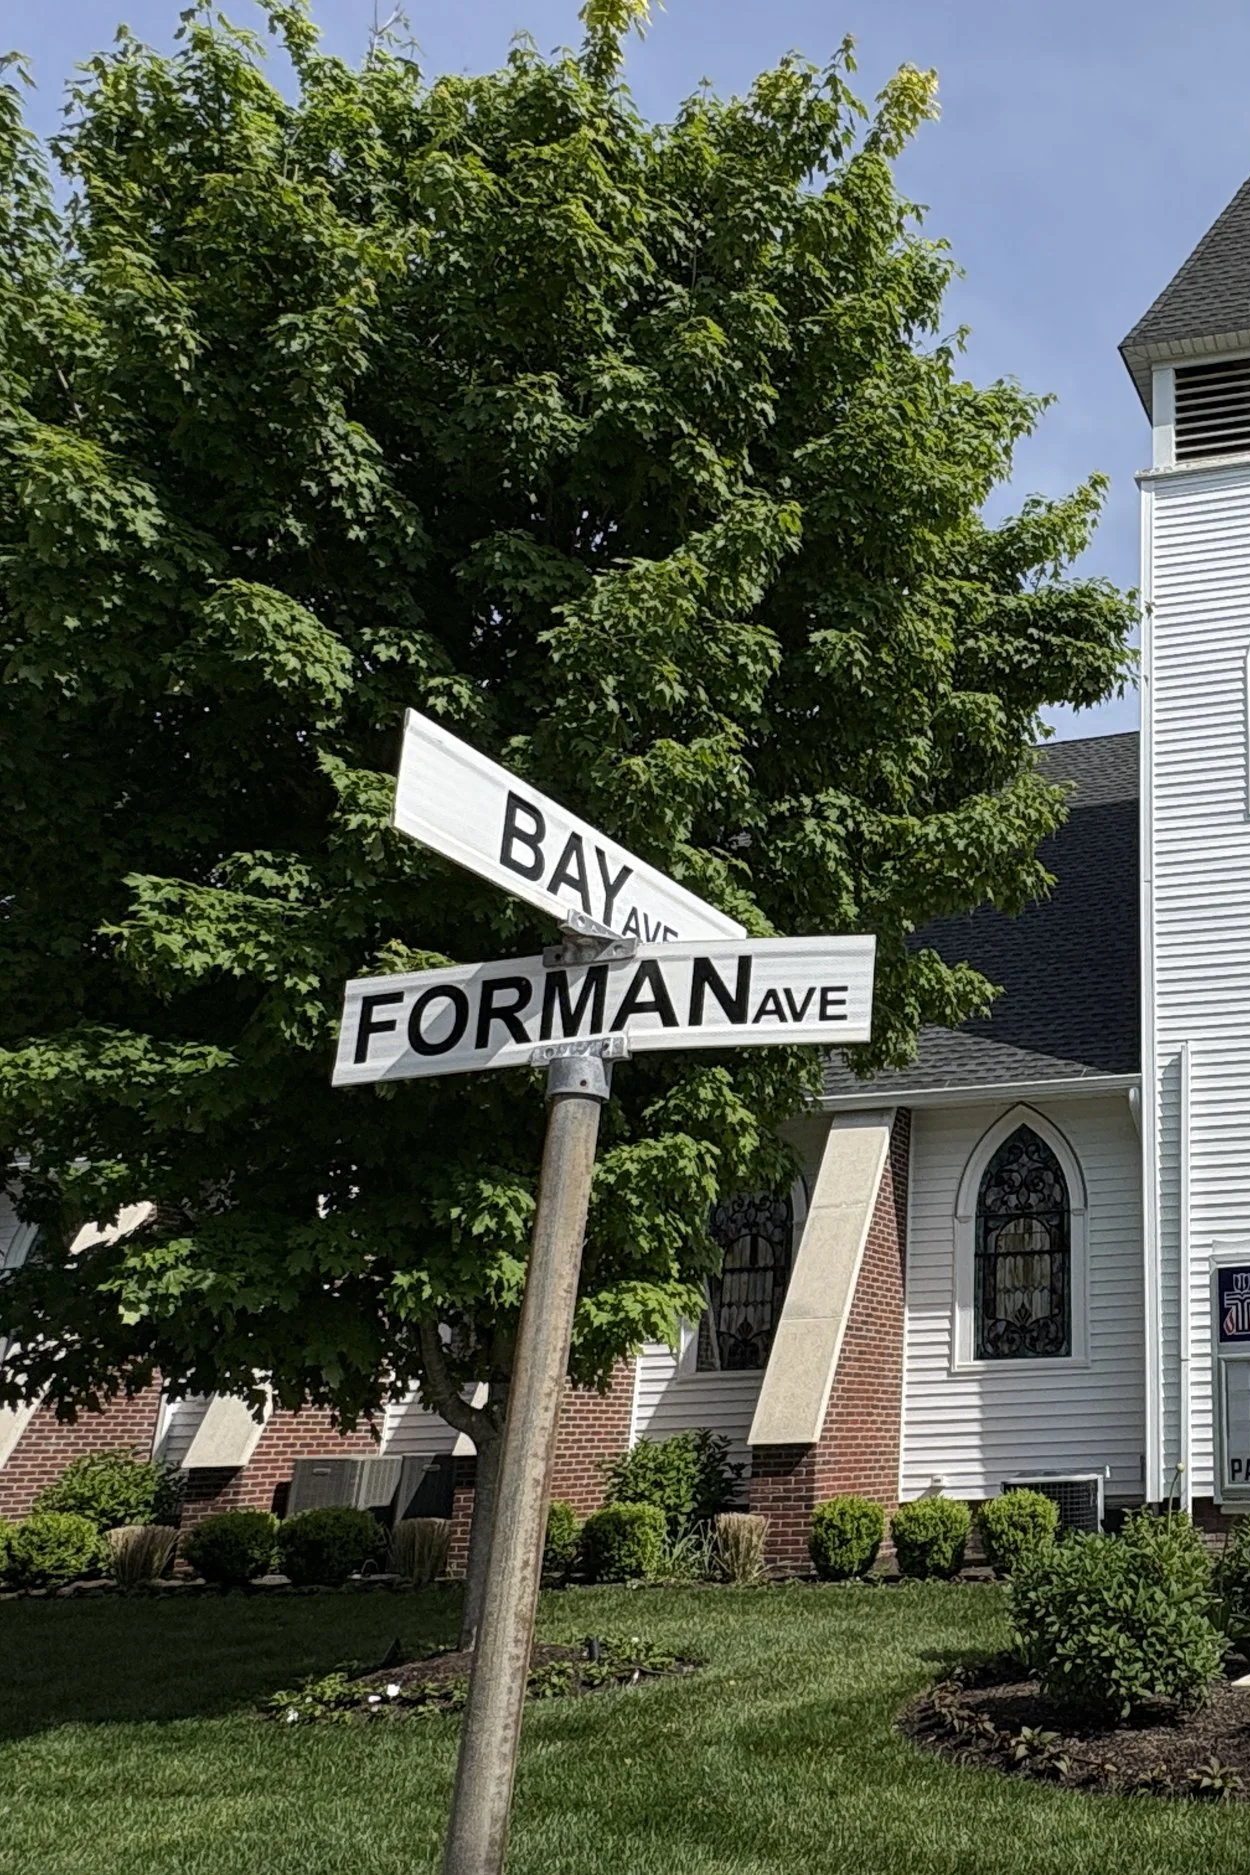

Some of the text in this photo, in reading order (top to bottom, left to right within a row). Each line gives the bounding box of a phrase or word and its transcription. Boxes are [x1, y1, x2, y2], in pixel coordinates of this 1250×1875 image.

[500, 790, 633, 928] BAY
[353, 955, 849, 1064] FORMAN AVE
